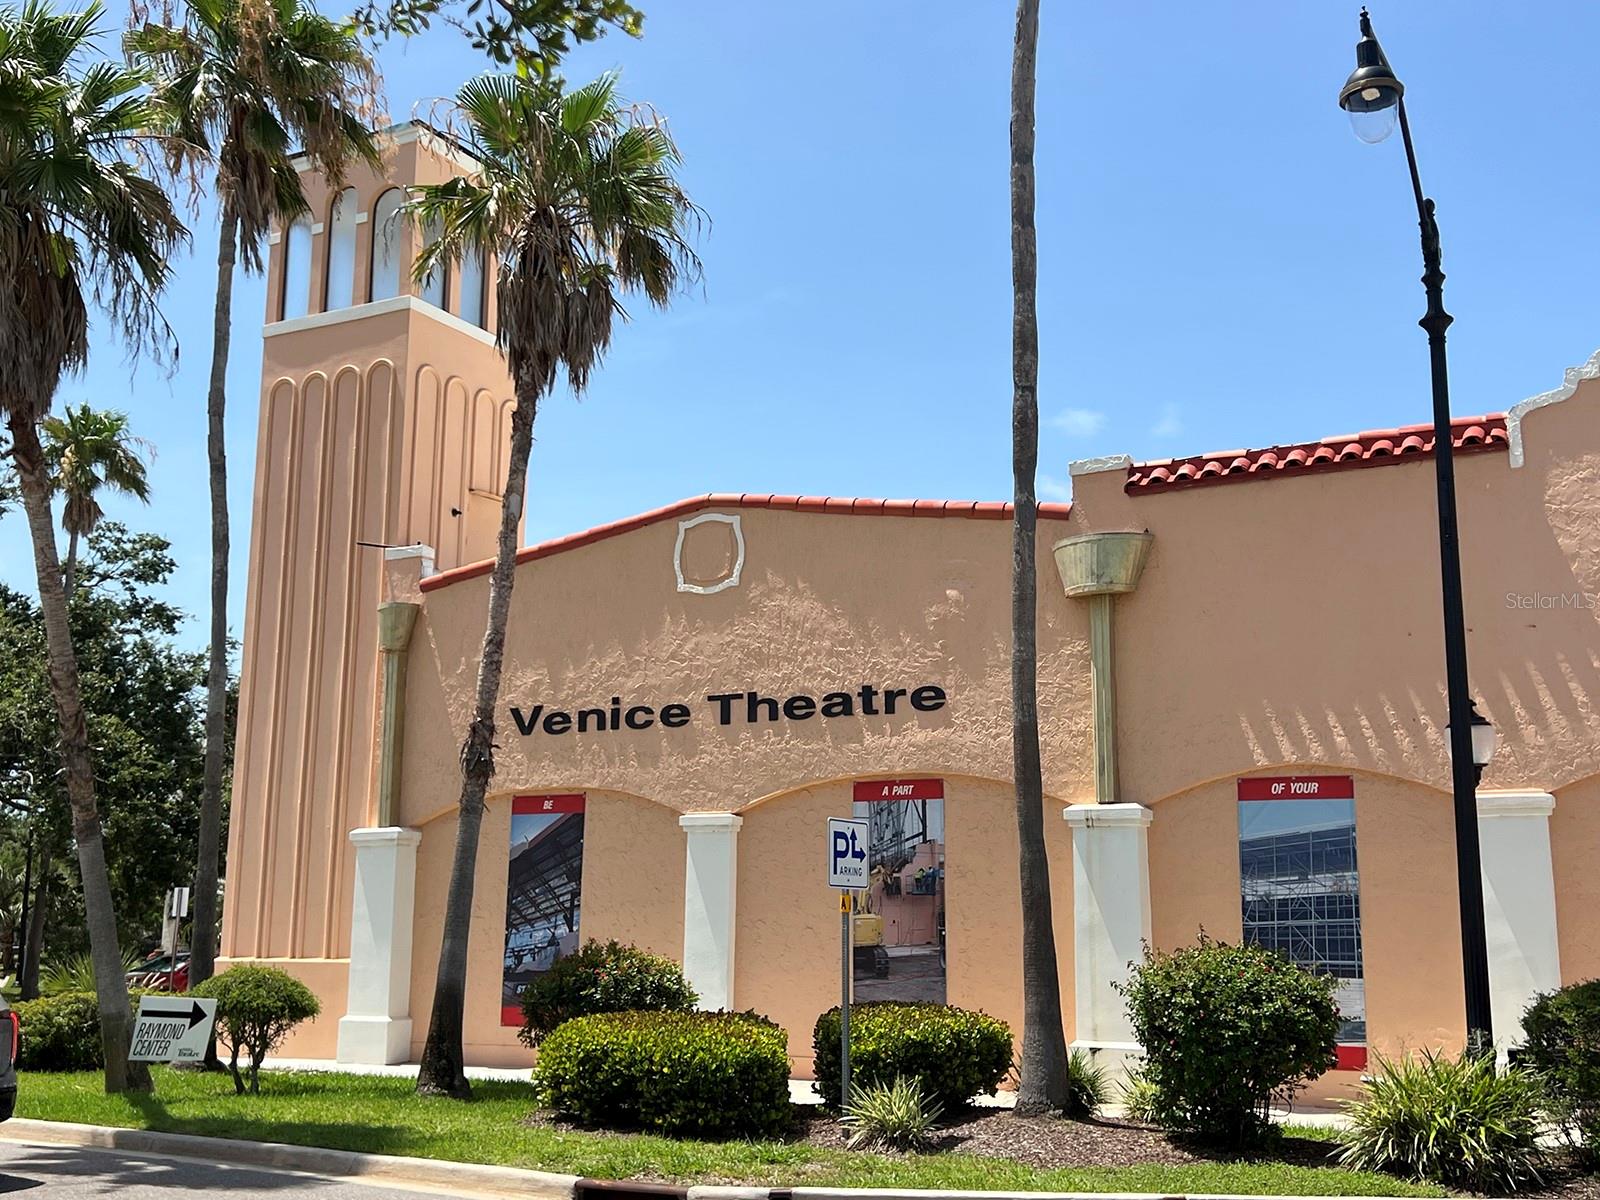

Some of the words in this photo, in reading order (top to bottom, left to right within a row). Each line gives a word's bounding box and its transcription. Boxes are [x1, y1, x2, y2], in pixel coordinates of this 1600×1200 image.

[510, 697, 690, 735] Venice
[707, 684, 947, 725] Theatre
[882, 786, 889, 796] A
[892, 785, 914, 796] PART
[1271, 783, 1286, 794] OF
[1290, 782, 1319, 794] YOUR
[543, 800, 554, 810] BE
[136, 1022, 186, 1040] RAYMOND
[132, 1039, 171, 1056] CENTER
